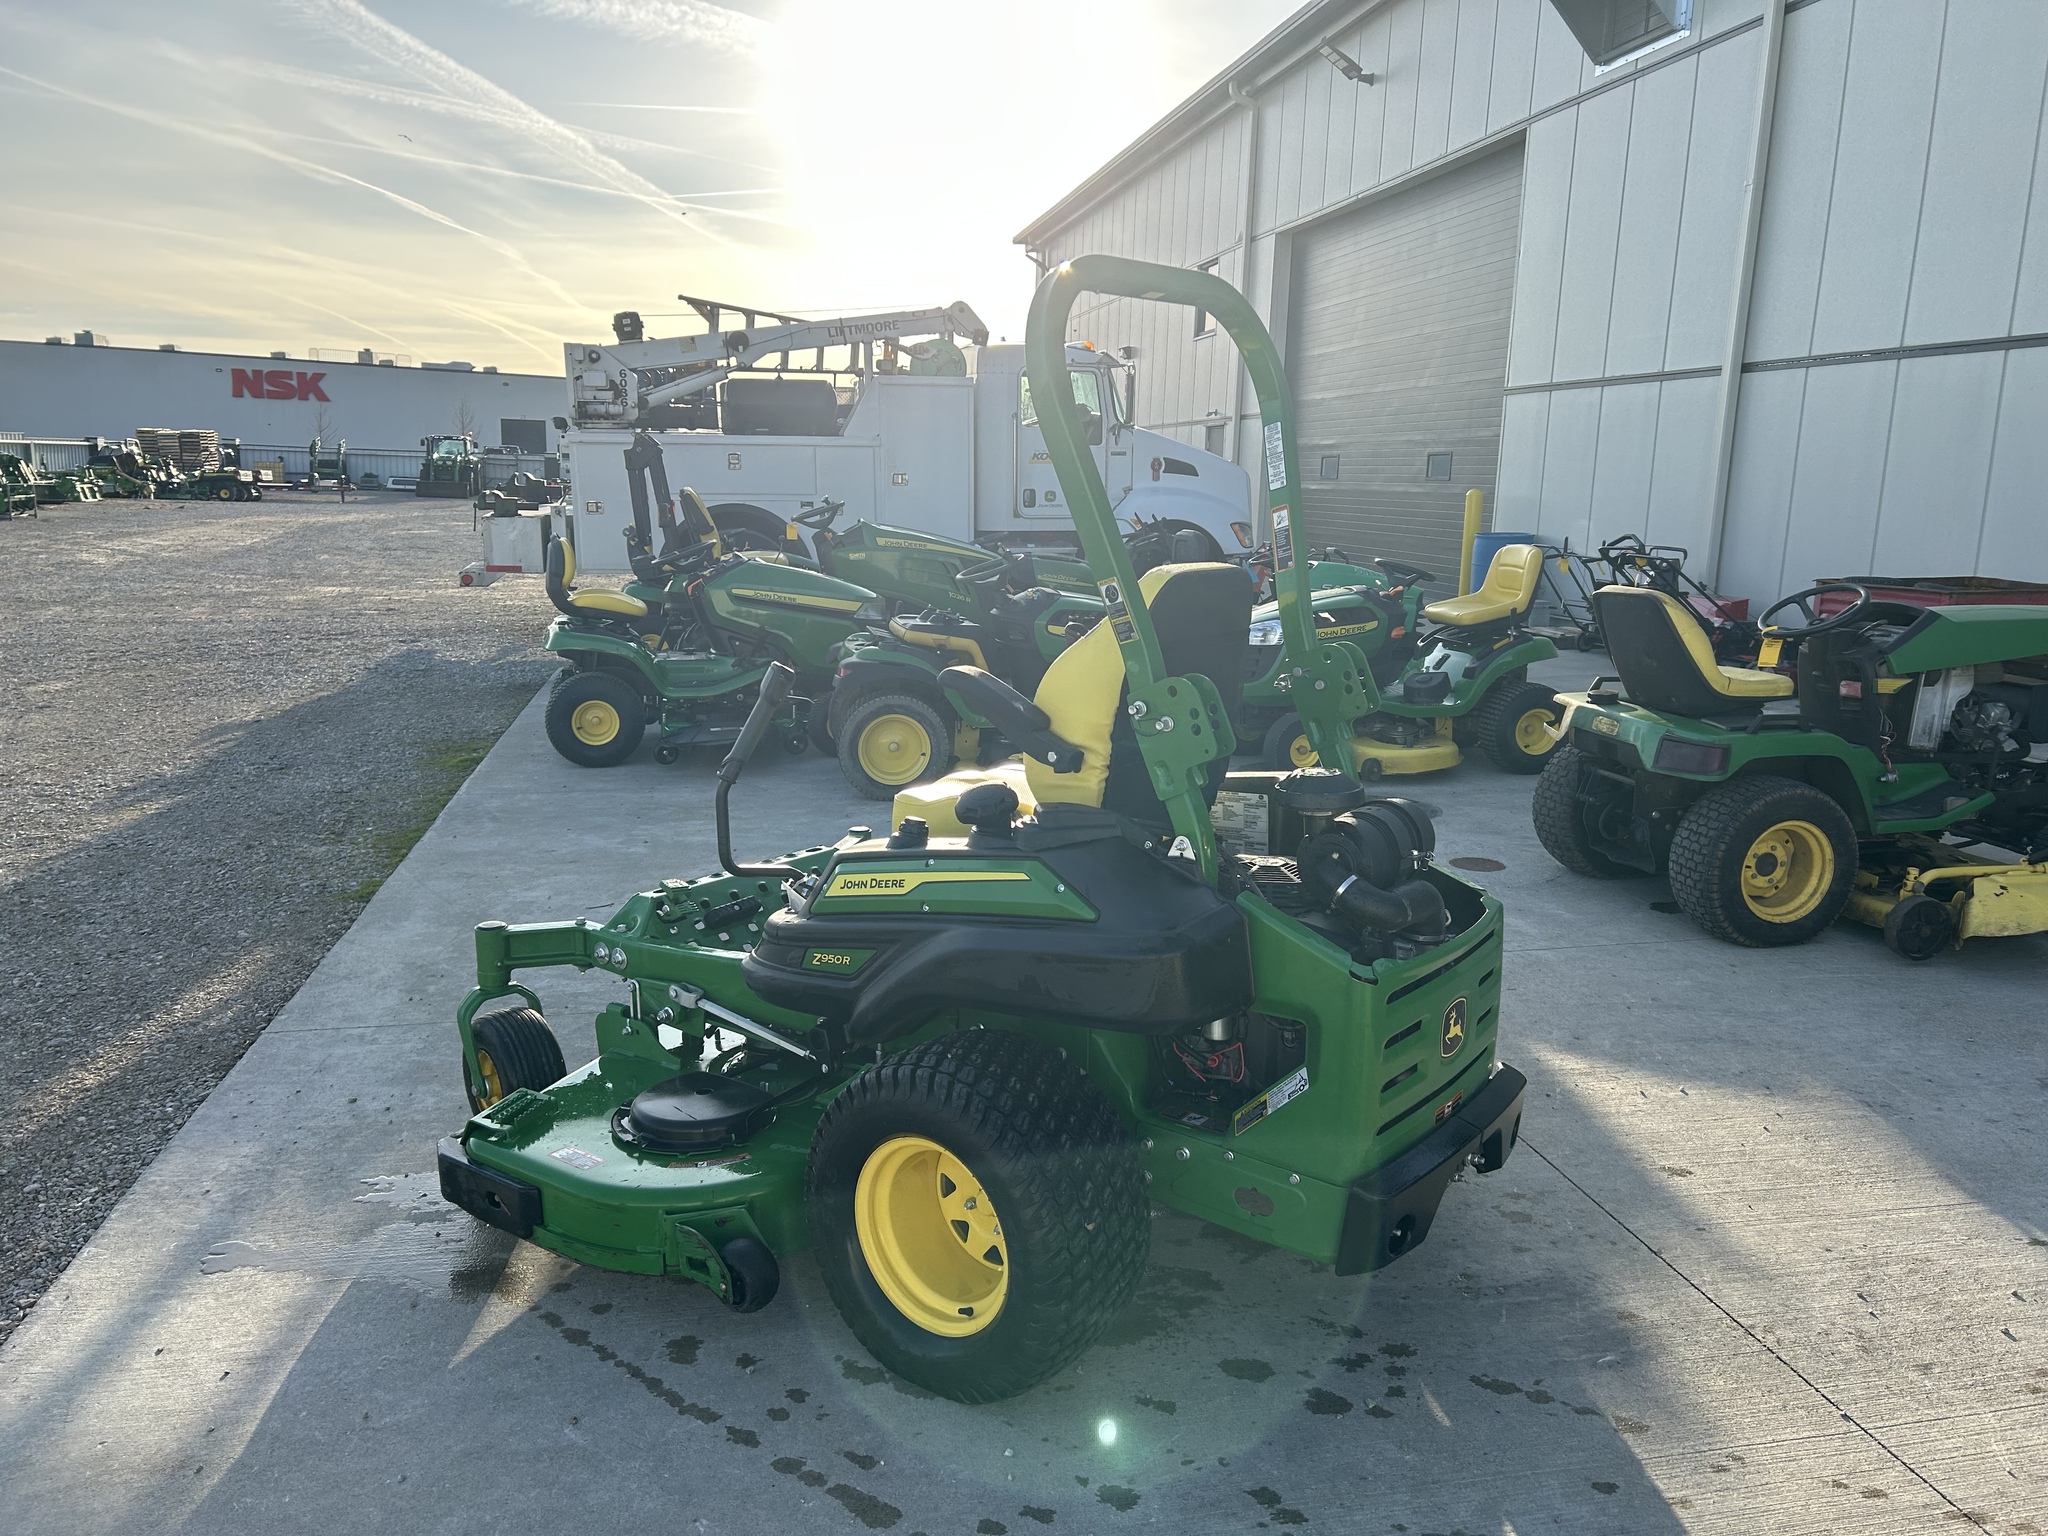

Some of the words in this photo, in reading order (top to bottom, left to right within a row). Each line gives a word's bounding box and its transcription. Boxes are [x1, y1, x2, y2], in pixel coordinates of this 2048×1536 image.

[231, 368, 331, 402] NSK
[619, 369, 628, 407] 6036
[882, 540, 903, 548] JOHN
[904, 541, 928, 549] DEERE
[752, 590, 772, 599] JOHN
[773, 594, 797, 604] DEERE
[1317, 630, 1338, 638] JOHN
[1340, 624, 1367, 634] DEERE
[840, 879, 868, 890] JOHN
[870, 878, 906, 889] DEERE
[812, 953, 851, 965] Z950R
